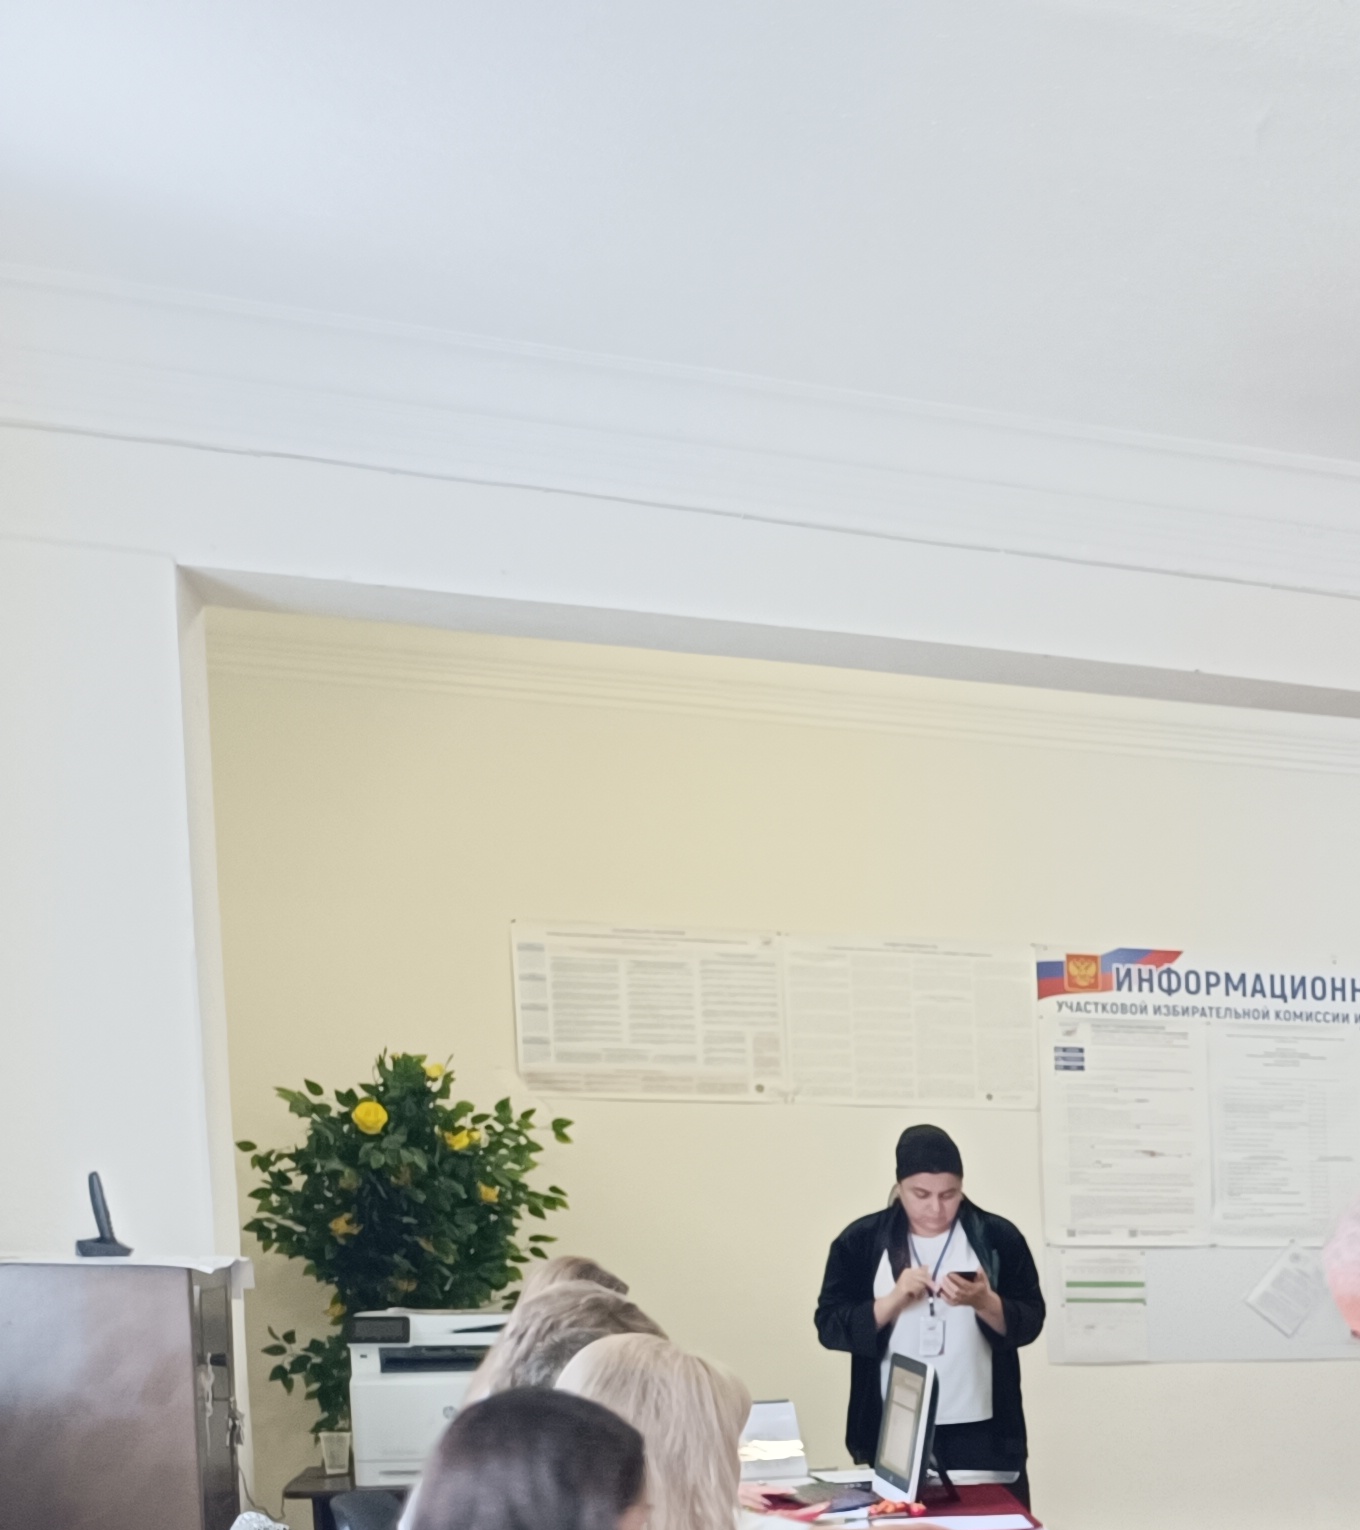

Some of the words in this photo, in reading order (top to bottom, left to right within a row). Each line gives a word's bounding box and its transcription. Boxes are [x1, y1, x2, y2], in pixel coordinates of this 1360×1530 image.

[1056, 1000, 1149, 1016] УЧАСТКОВОЙ
[1153, 1003, 1271, 1022] ИЗБИРАТЕЛЬНОЙ
[1274, 1009, 1350, 1024] КОМИССИИ
